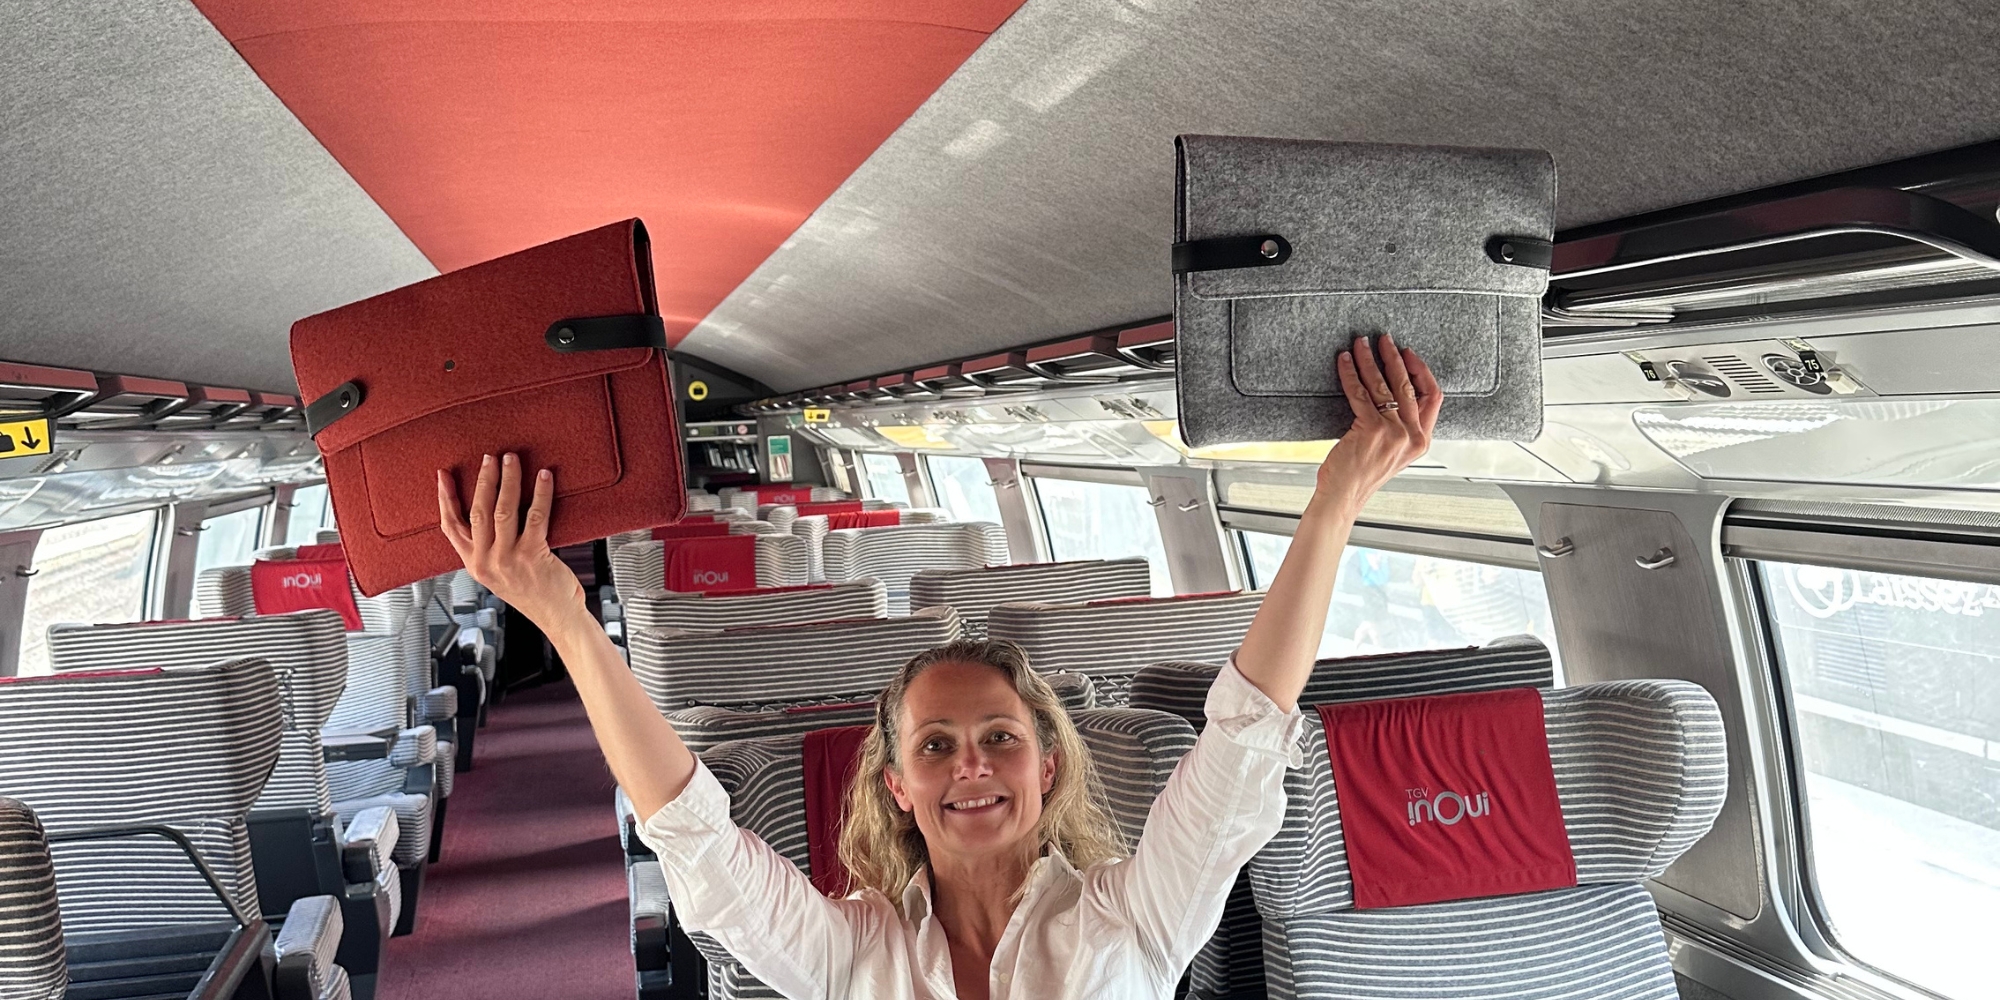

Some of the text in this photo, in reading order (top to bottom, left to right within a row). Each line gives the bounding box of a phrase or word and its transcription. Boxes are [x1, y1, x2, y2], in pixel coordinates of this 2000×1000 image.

[1804, 359, 1820, 371] 75
[1643, 369, 1656, 379] 76
[1405, 787, 1429, 799] TGV
